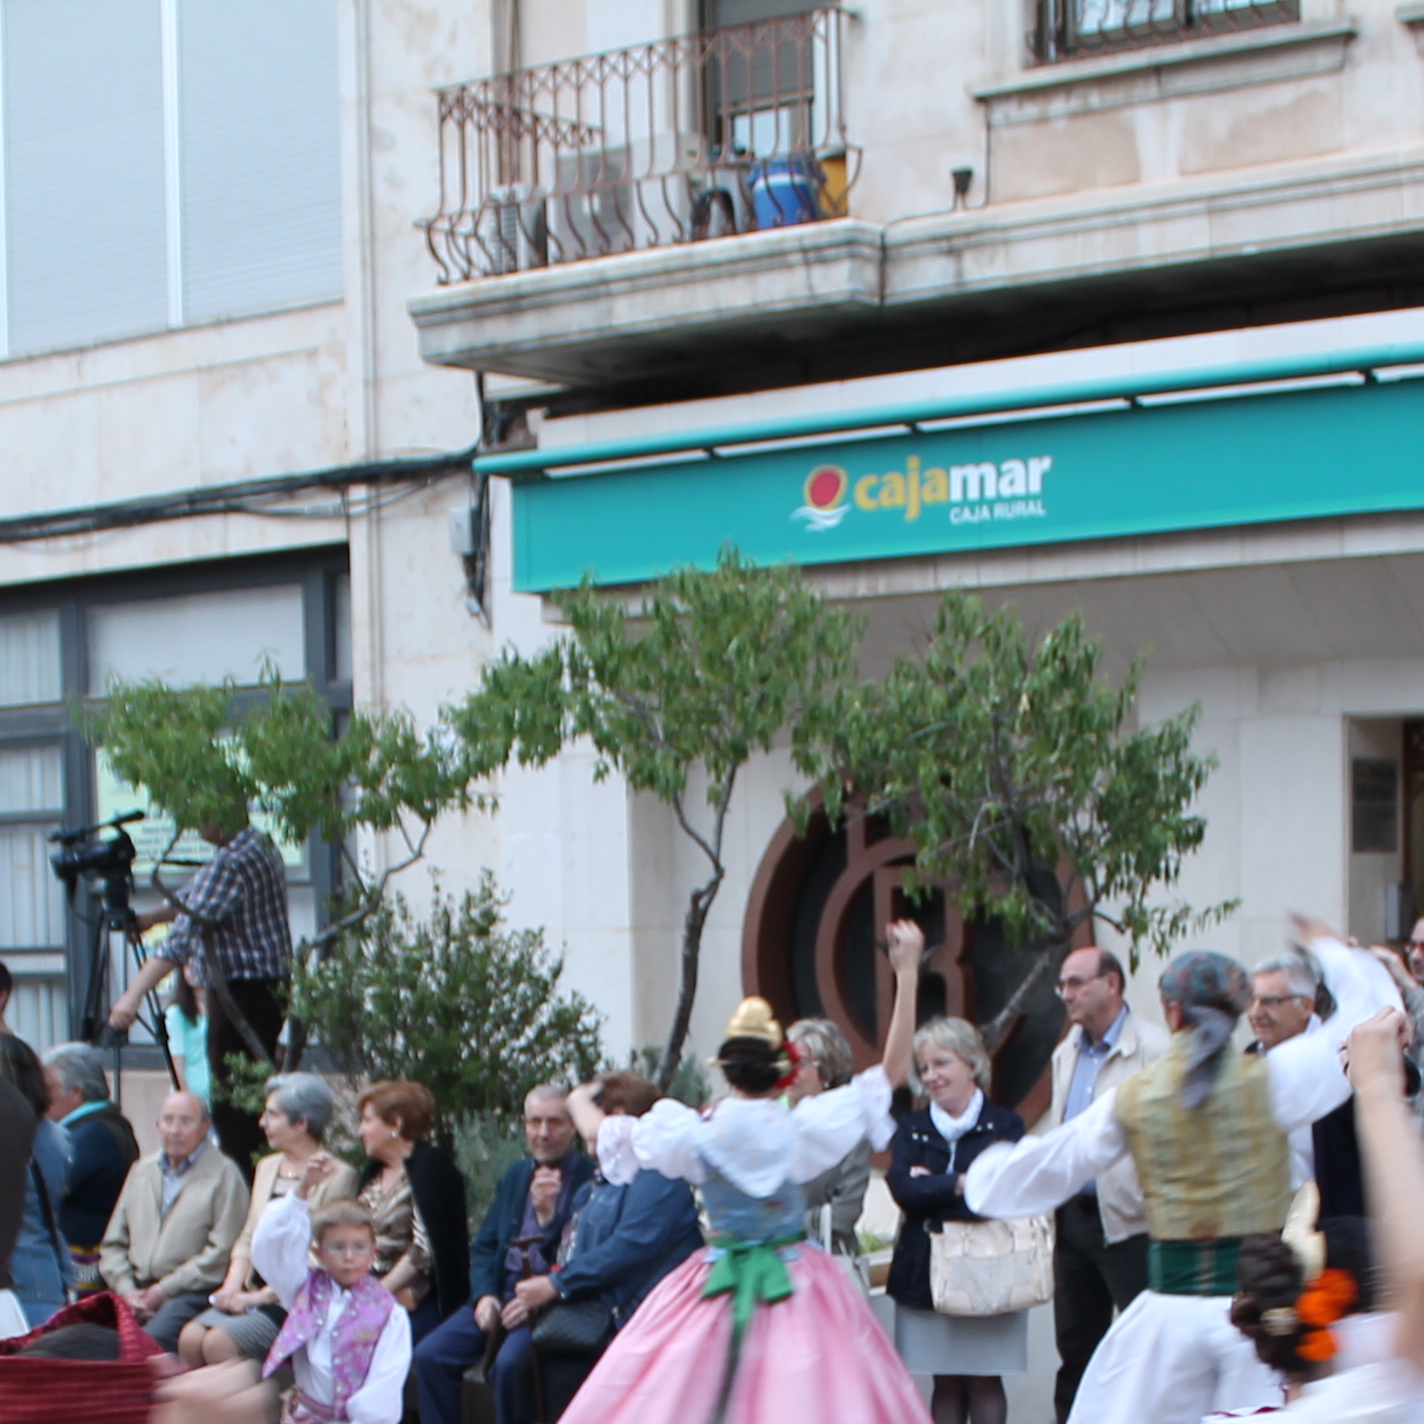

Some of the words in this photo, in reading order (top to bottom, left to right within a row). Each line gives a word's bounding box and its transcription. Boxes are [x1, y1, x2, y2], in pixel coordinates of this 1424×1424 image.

[854, 454, 1053, 523] cajamar
[949, 505, 992, 525] CAJA
[994, 499, 1047, 521] RURAL
